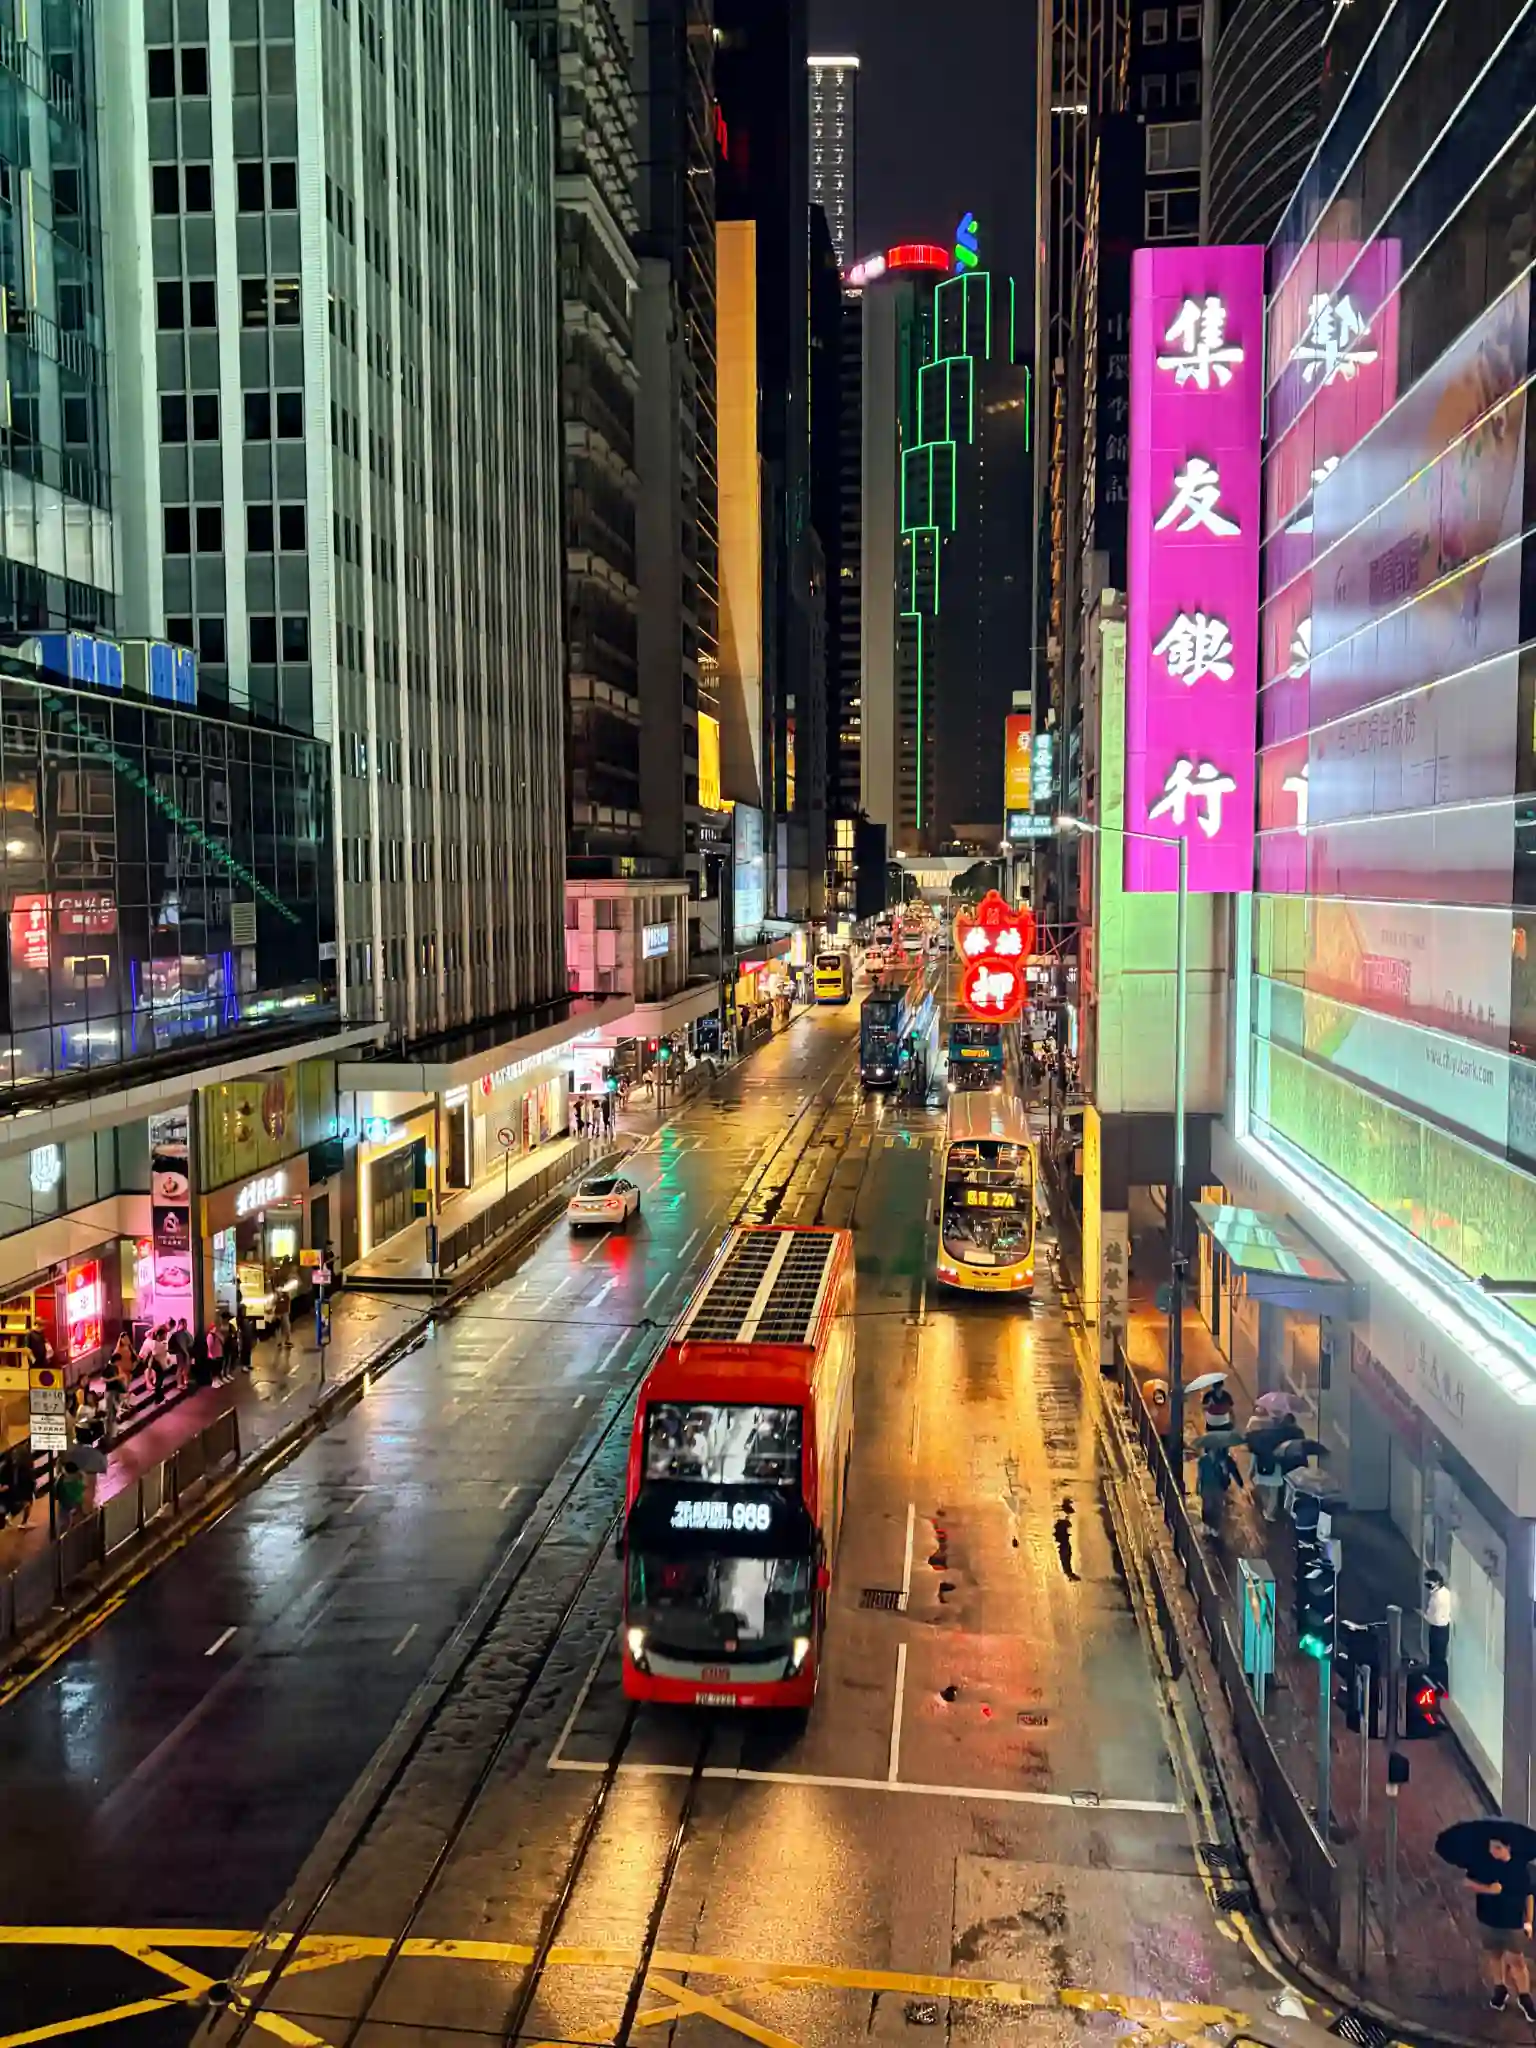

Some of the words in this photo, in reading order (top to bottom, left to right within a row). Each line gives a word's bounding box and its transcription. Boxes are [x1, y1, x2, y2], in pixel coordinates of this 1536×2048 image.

[1149, 296, 1244, 838] 集友銀行
[992, 1191, 1015, 1207] 37A
